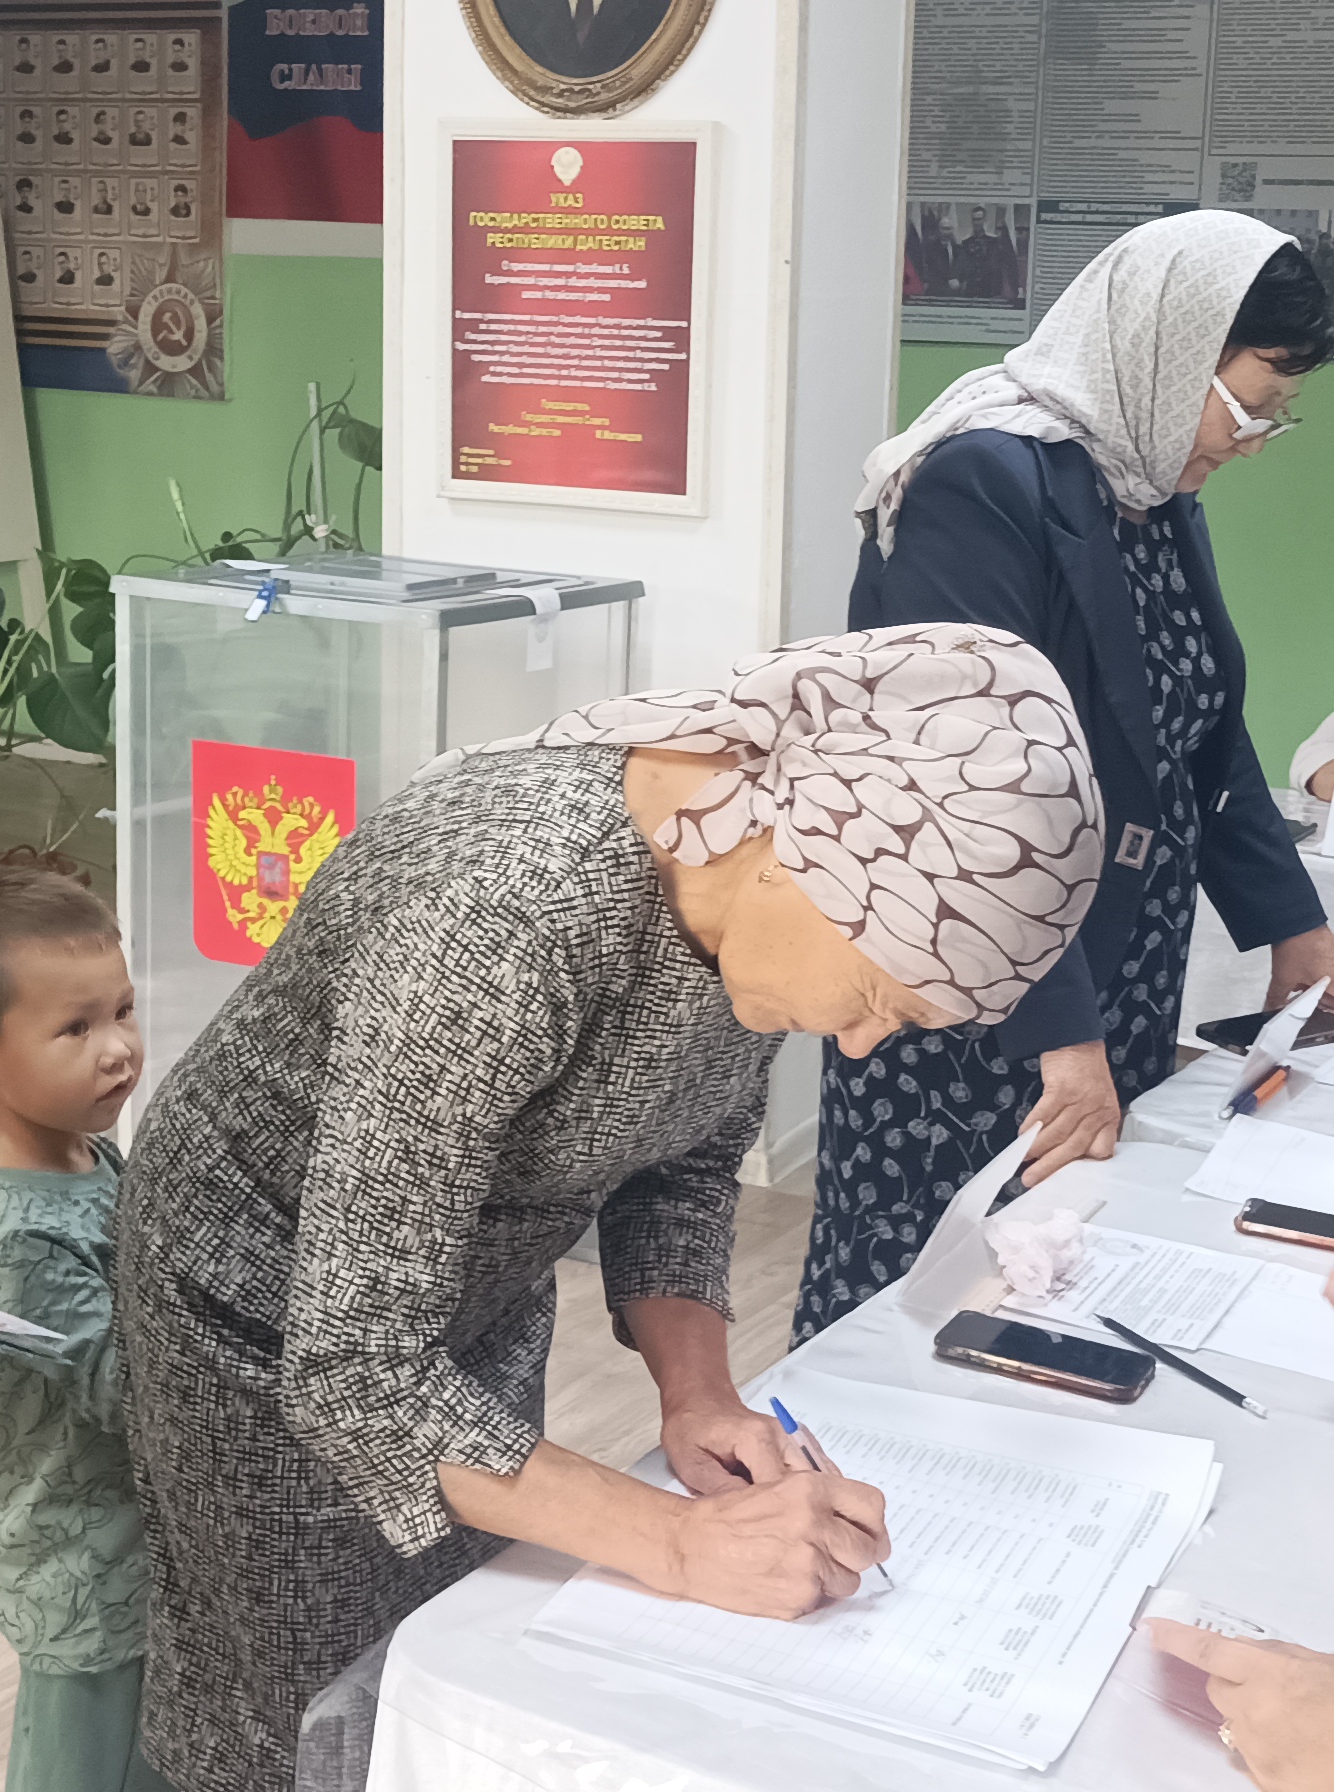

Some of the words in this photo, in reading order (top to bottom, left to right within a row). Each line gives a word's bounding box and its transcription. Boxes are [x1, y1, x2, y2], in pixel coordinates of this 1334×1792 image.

[265, 3, 369, 35] БОЕВОЙ
[271, 63, 362, 90] СЛАВЫ
[549, 193, 584, 208] УКАЗ
[469, 211, 608, 229] ГОСУДАРСТВЕННОГО
[610, 214, 666, 230] СОВЕТА
[486, 232, 574, 249] РЕСПУБЛИКИ
[575, 234, 646, 251] ДАГЕСТАН
